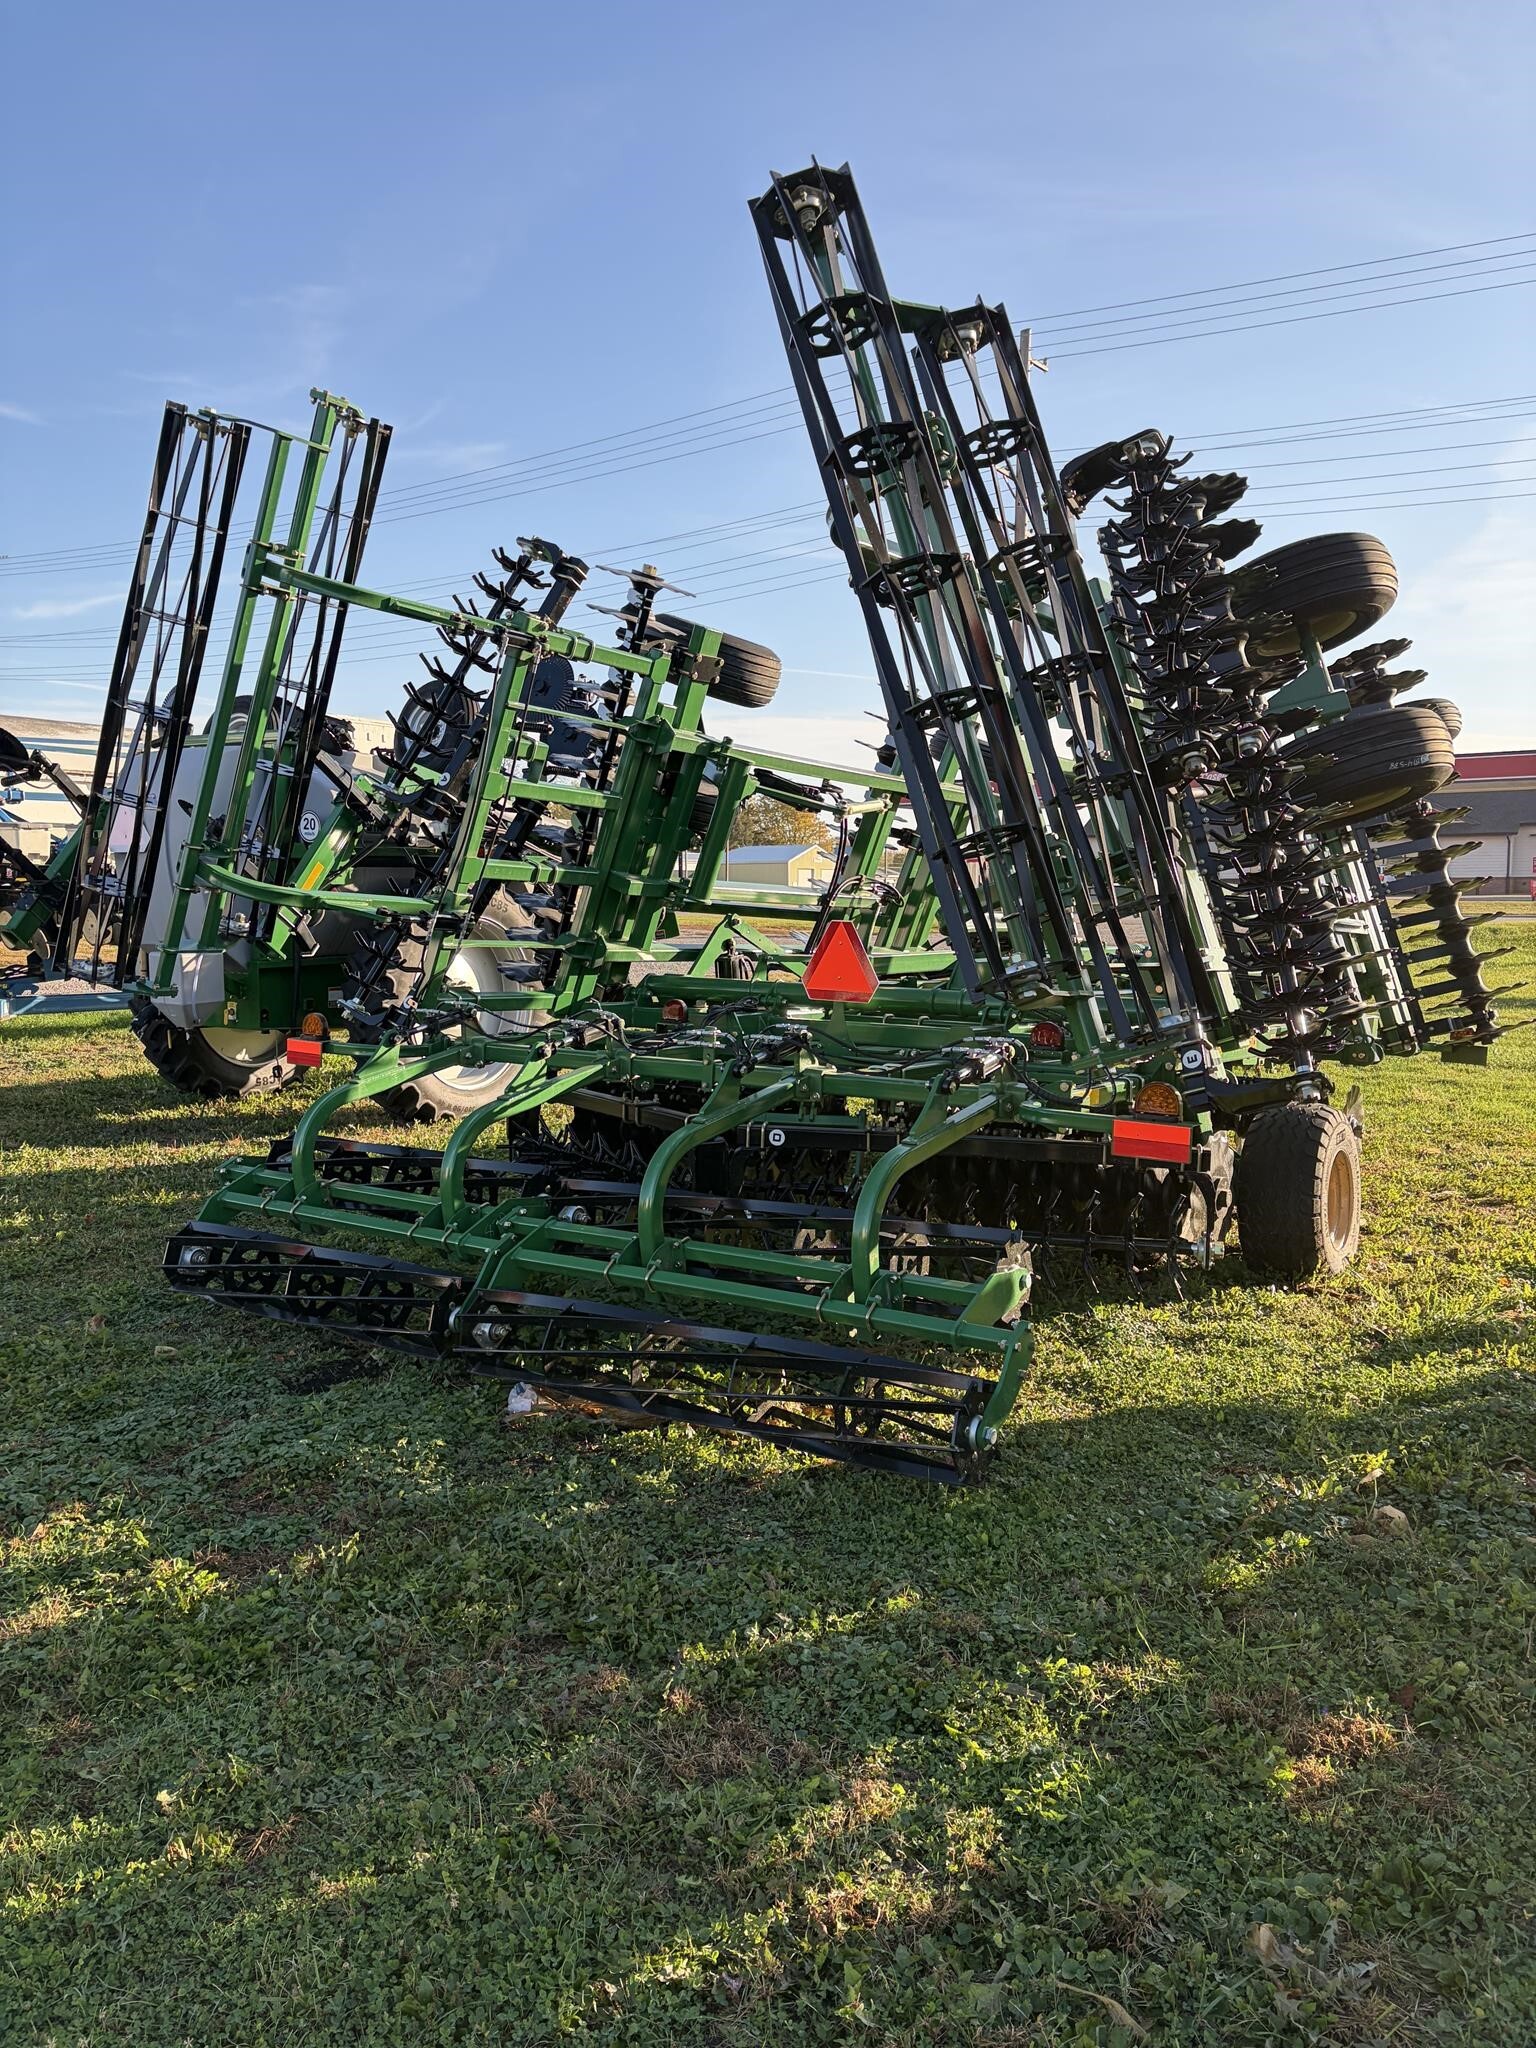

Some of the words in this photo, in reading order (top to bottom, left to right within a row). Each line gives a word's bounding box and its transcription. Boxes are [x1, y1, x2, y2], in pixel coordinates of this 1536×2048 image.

[303, 817, 316, 831] 20
[490, 897, 509, 913] C85
[1186, 1054, 1198, 1064] E
[256, 1075, 280, 1086] C85
